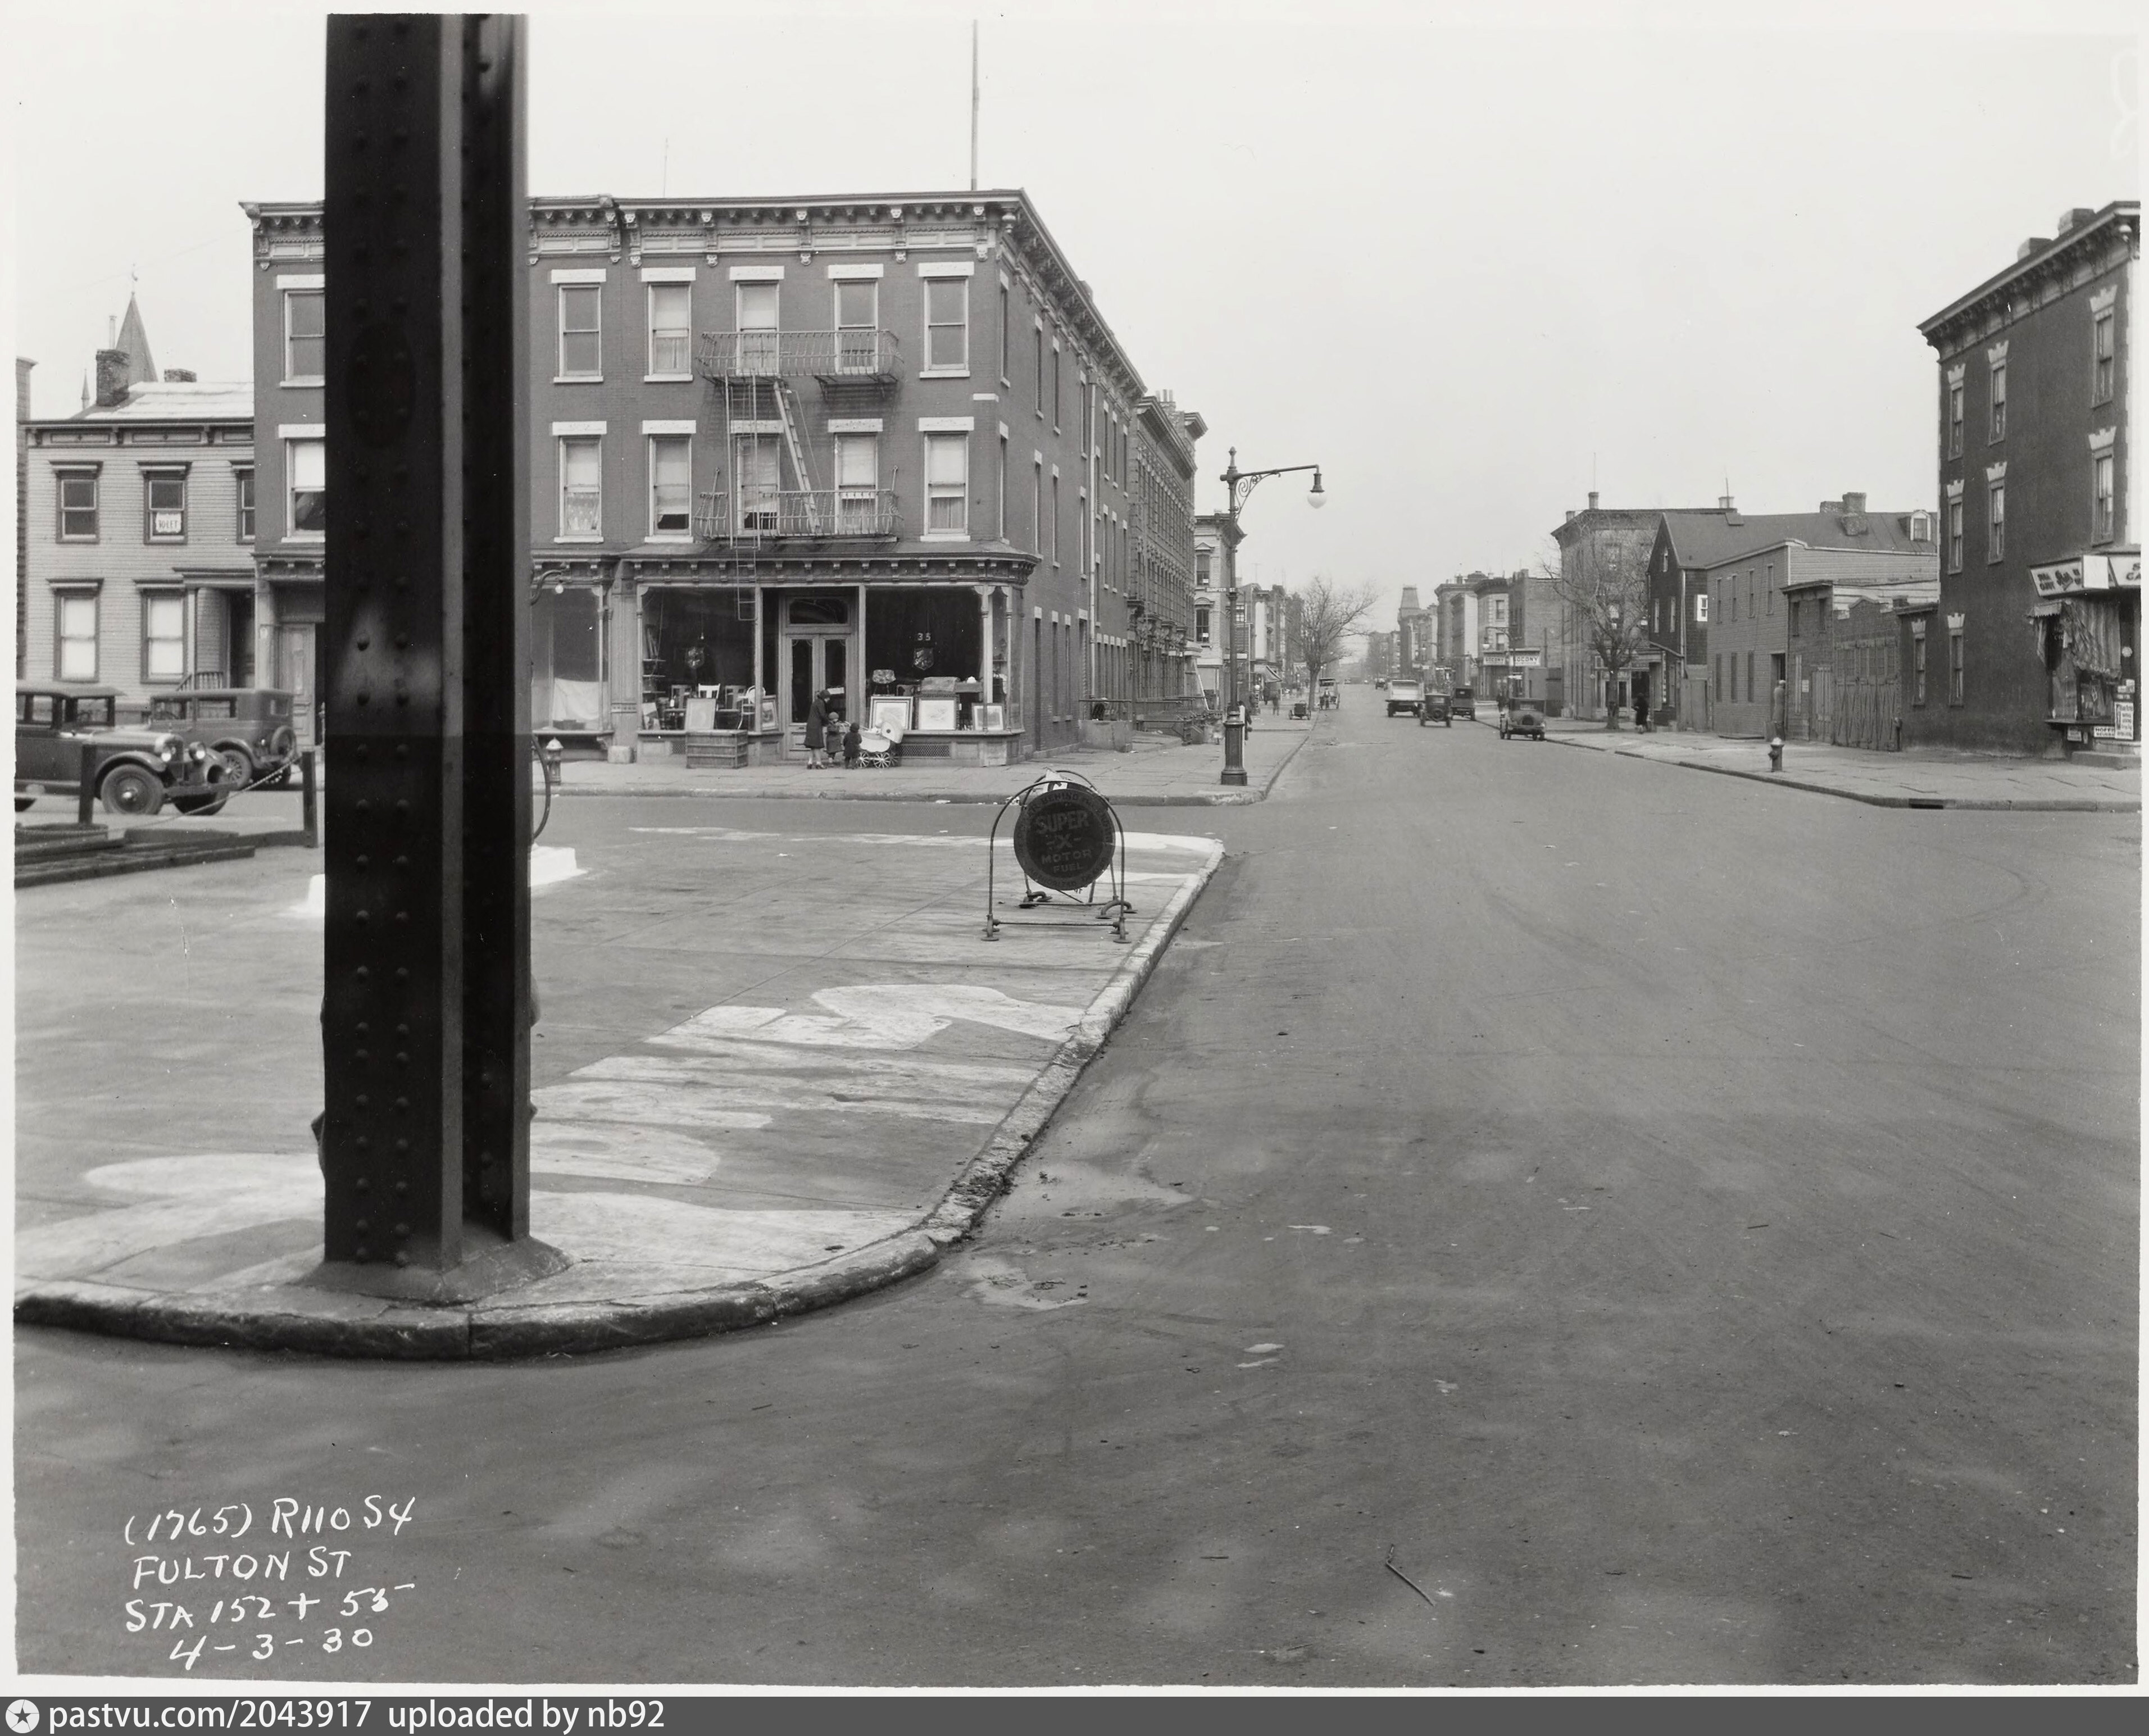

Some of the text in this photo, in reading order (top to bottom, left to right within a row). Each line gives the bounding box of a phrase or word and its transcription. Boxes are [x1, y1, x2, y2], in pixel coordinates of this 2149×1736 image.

[917, 632, 931, 641] 35
[1036, 810, 1089, 835] SUPER
[1041, 849, 1092, 865] MOTOR
[1053, 862, 1084, 874] FUEL
